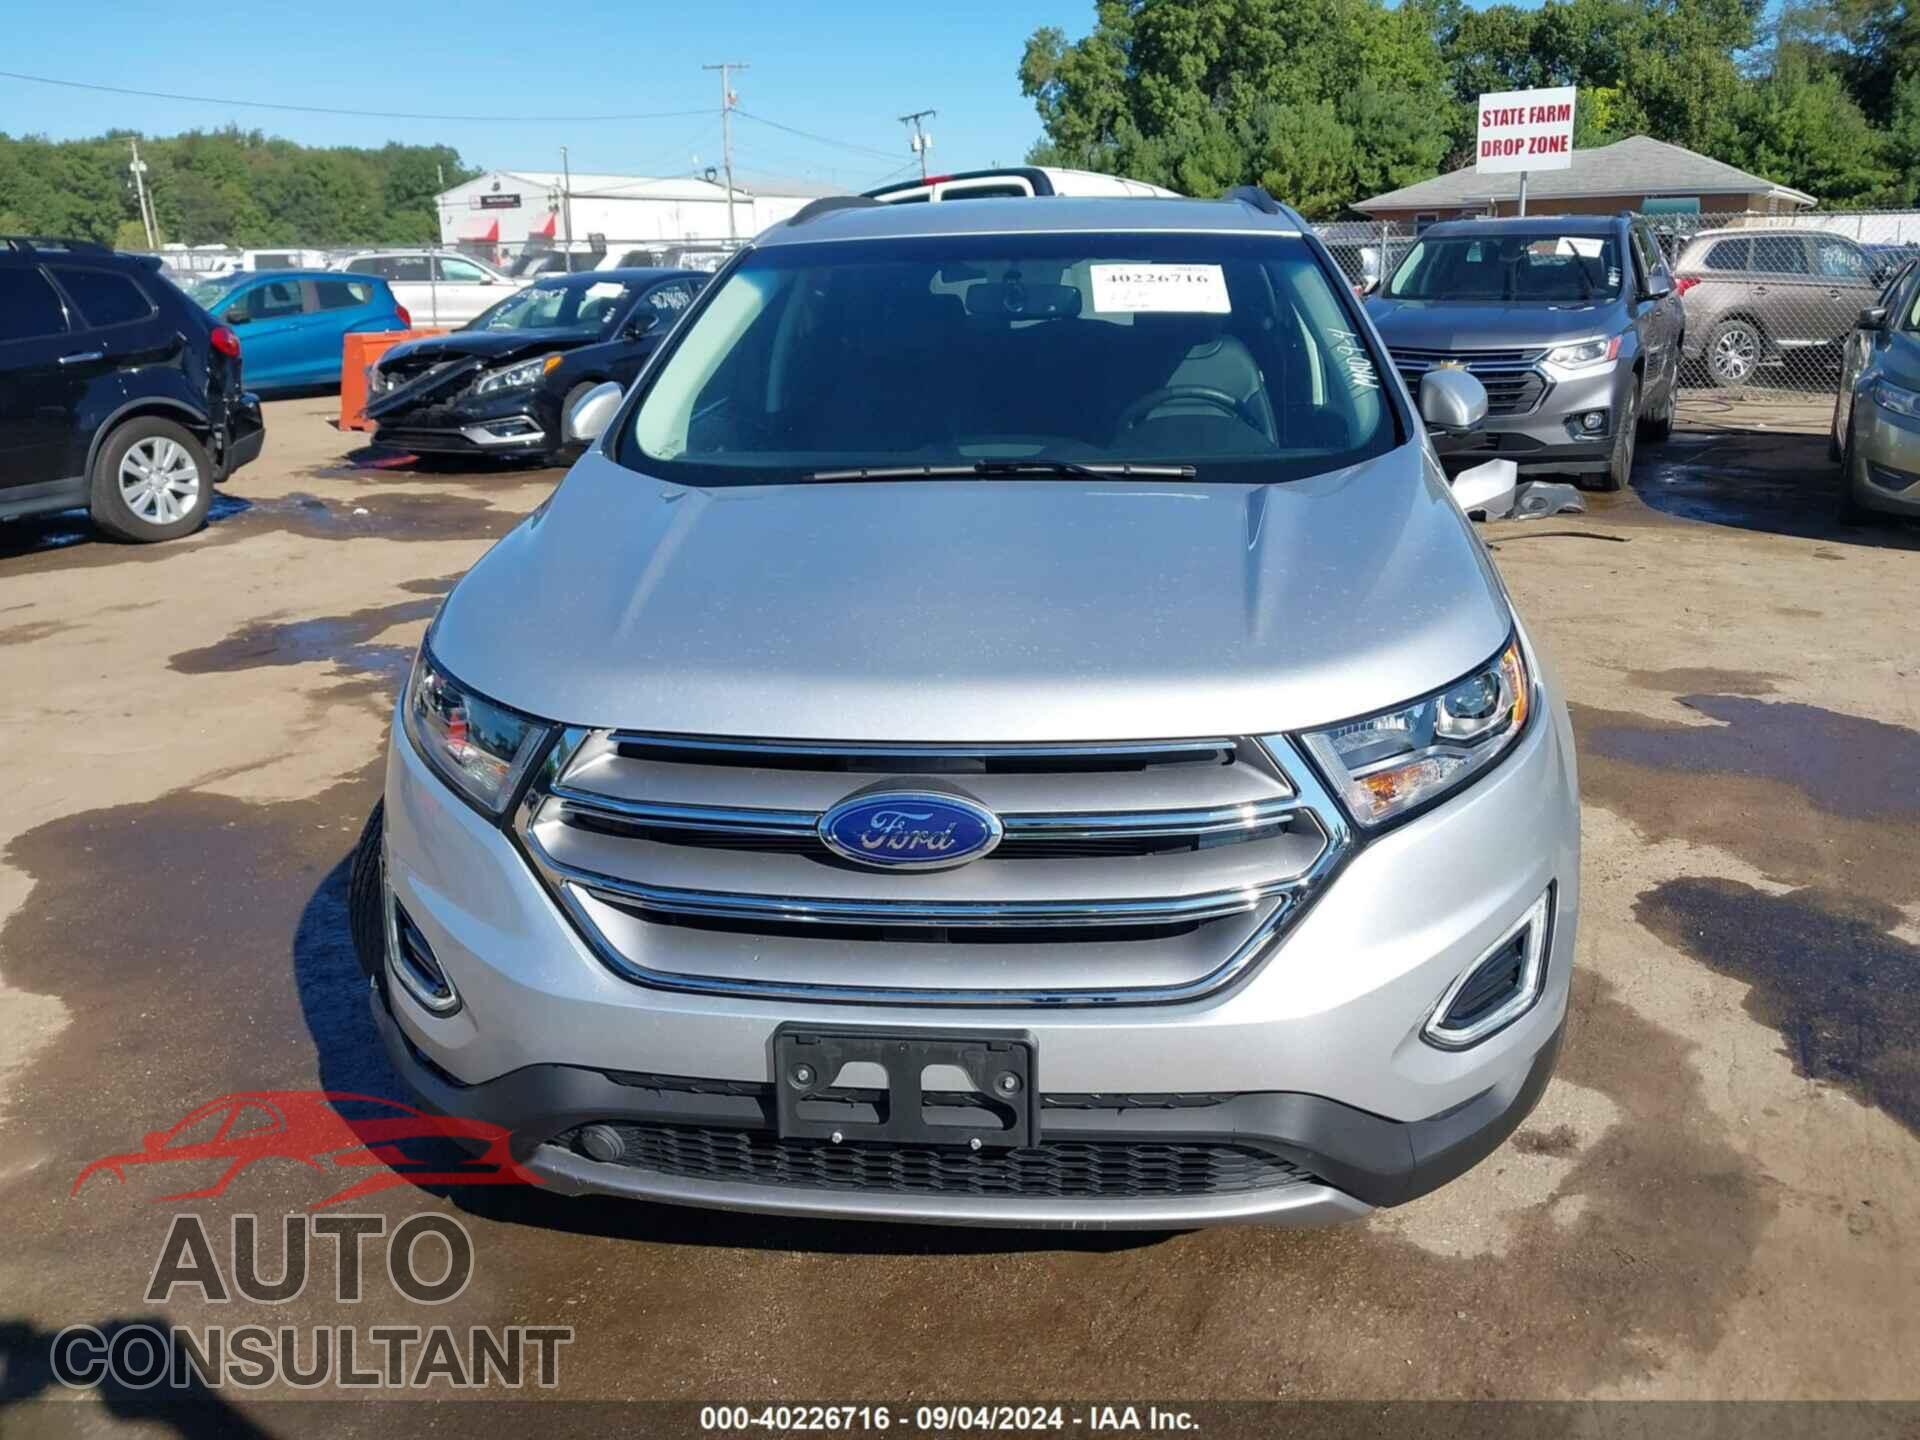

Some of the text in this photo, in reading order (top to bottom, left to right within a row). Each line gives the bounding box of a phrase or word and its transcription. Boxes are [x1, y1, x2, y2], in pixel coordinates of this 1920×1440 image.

[1482, 104, 1571, 127] STATE FARM
[1481, 135, 1568, 157] DROP ZONE
[1106, 273, 1209, 283] 40226716
[860, 810, 956, 850] Ford
